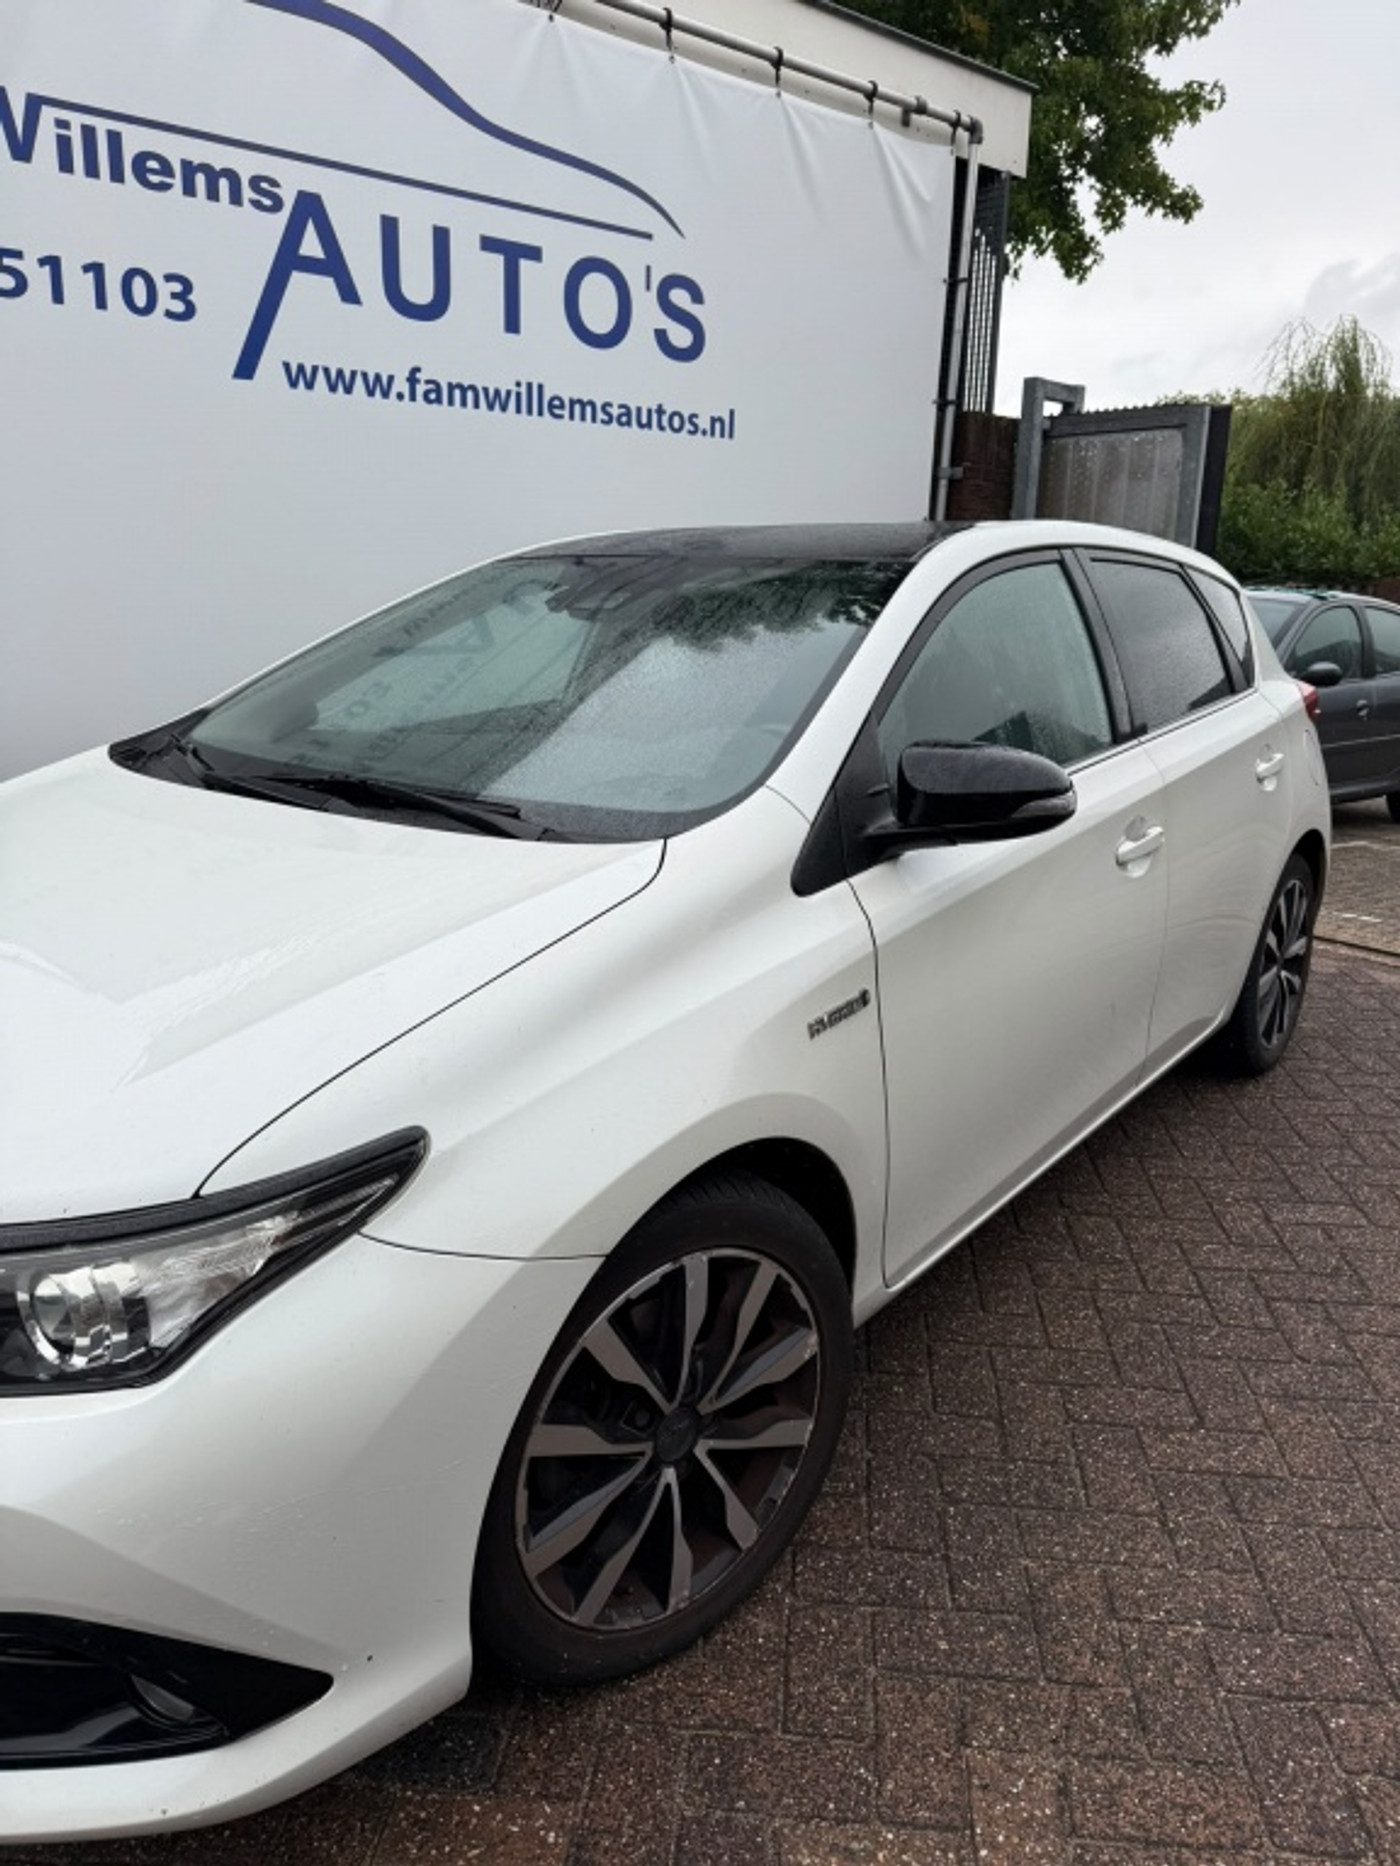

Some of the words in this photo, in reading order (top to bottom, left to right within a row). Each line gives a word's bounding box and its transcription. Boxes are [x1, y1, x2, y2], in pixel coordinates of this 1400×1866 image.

[0, 246, 197, 322] 51103
[231, 189, 706, 381] AUTO'S
[281, 360, 736, 440] www.famwillemsautos.nl
